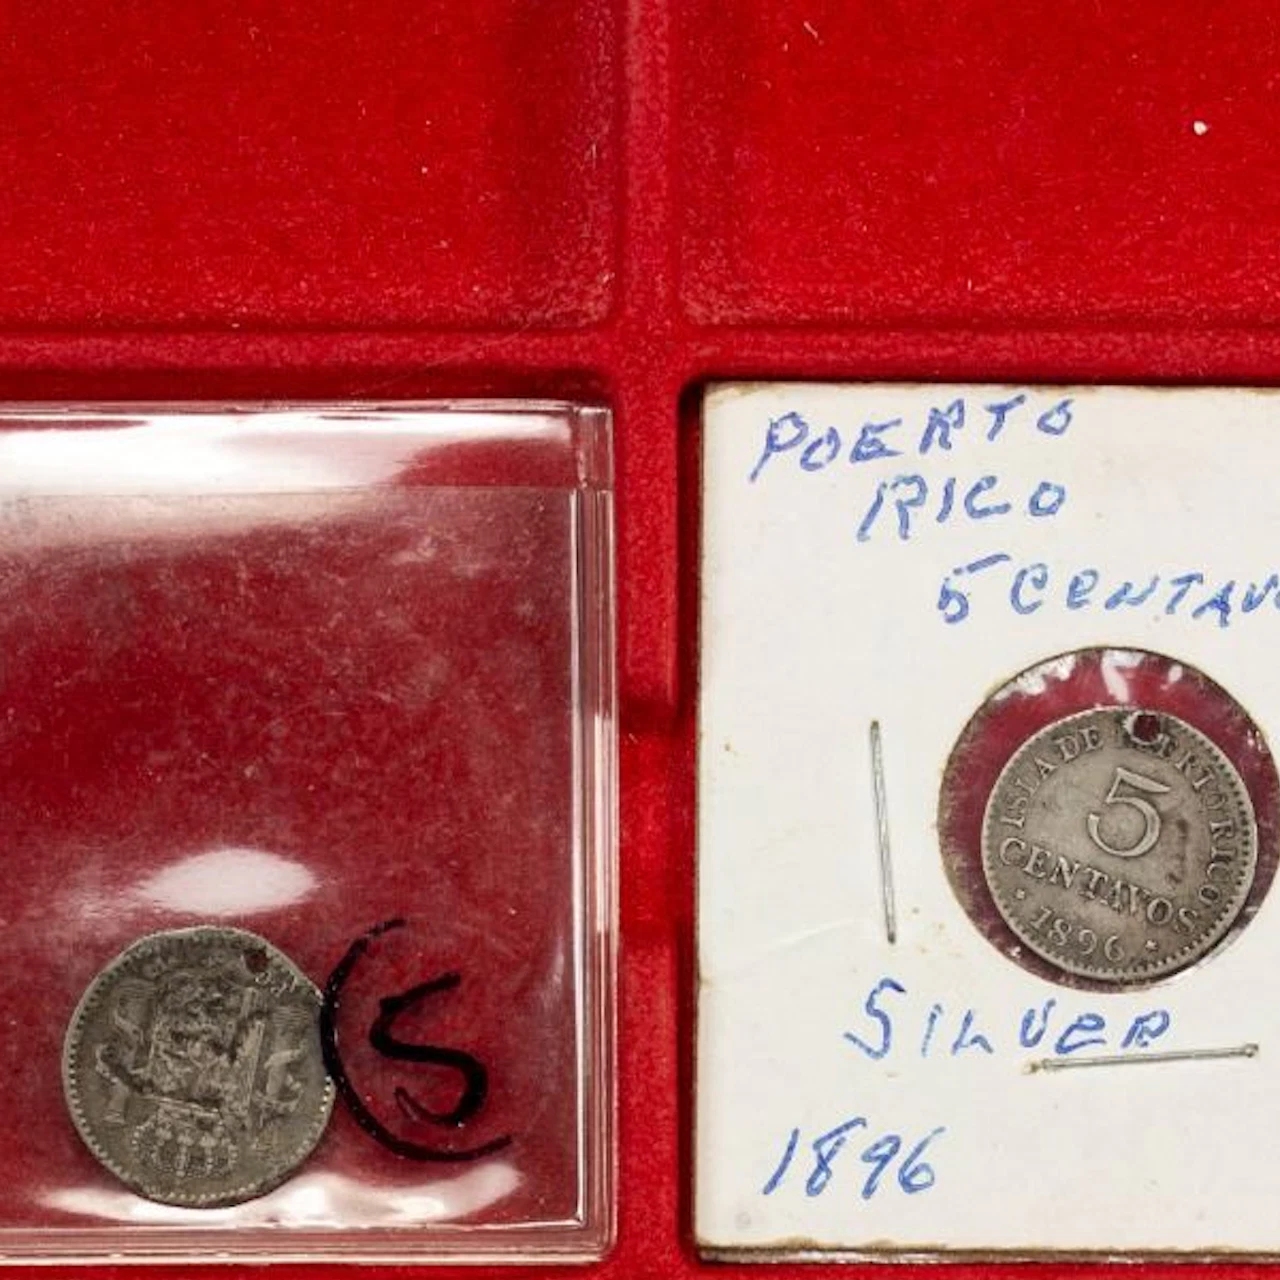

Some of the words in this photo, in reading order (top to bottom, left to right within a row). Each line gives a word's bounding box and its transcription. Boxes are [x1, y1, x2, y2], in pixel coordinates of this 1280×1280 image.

[856, 474, 1067, 542] RICO
[1086, 766, 1172, 858] 5
[999, 836, 1199, 937] CENTAVOS
[1029, 904, 1126, 962] 1896
[762, 1116, 946, 1200] 1896
